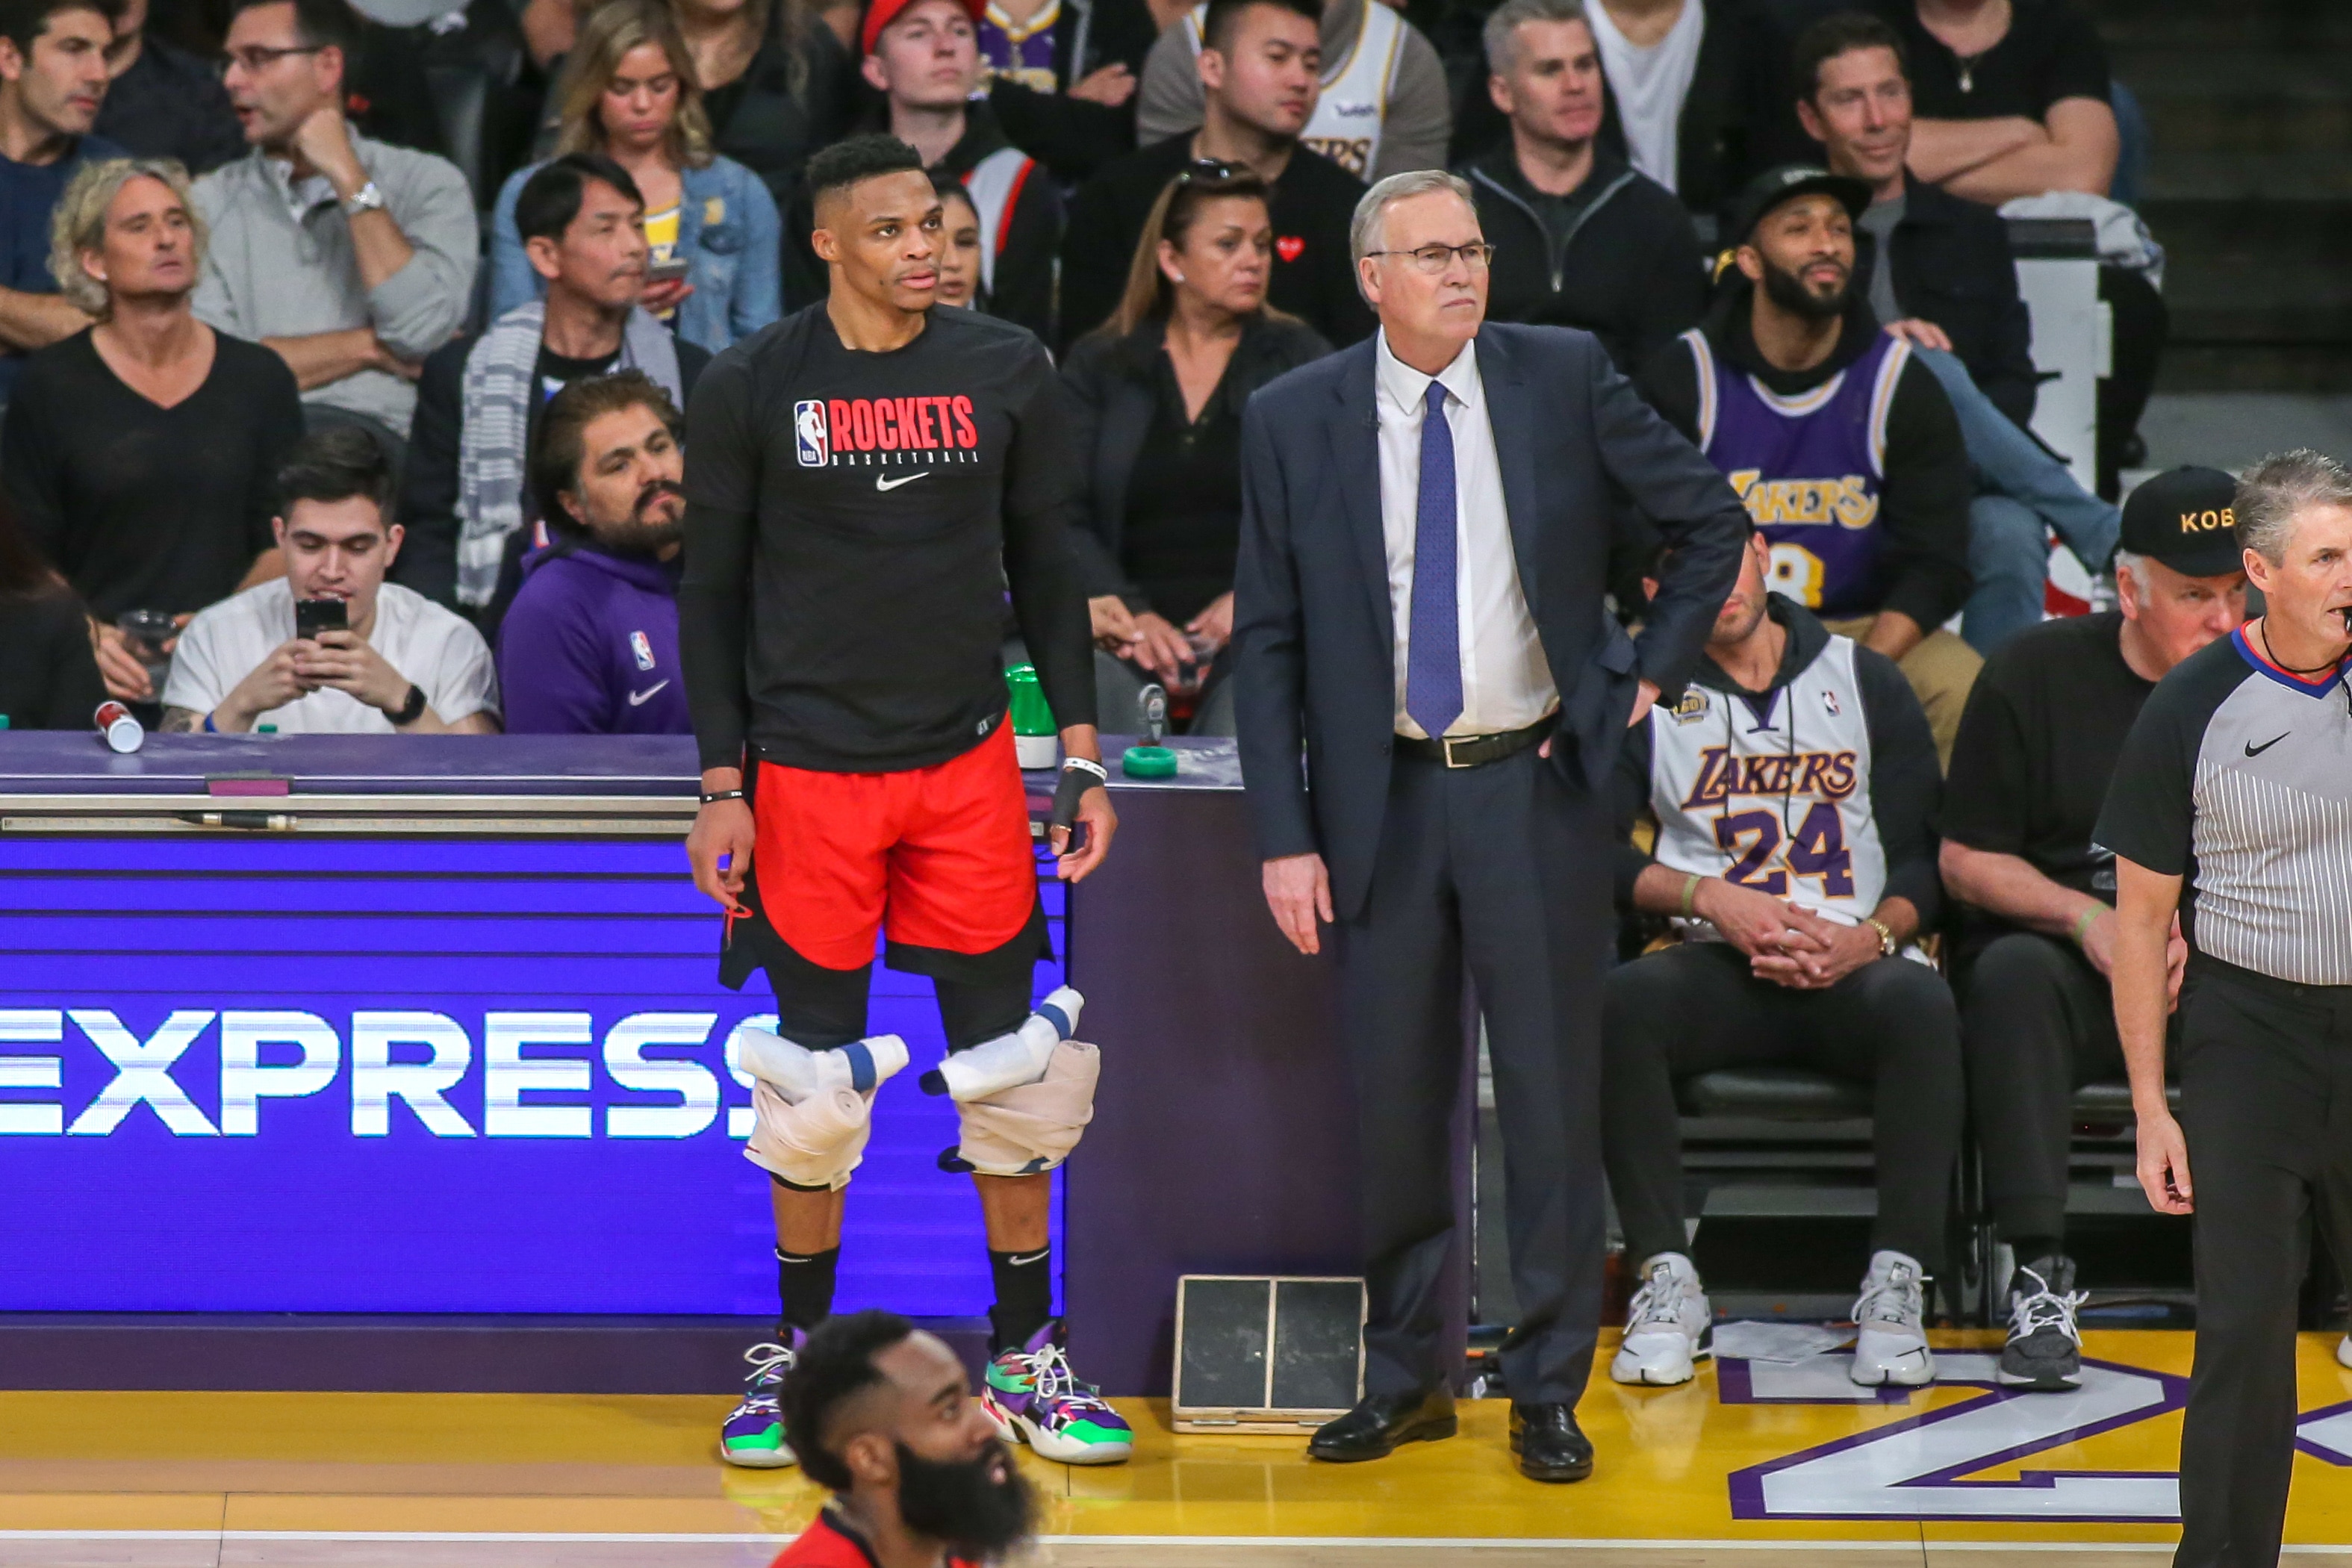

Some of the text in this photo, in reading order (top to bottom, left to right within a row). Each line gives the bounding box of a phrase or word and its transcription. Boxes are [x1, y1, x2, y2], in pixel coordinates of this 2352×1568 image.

[829, 395, 978, 452] ROCKETS
[801, 449, 817, 462] NBA
[832, 451, 978, 466] BASKETBALL
[2181, 508, 2235, 533] KOB
[1681, 744, 1858, 812] LAKERS
[1711, 801, 1855, 899] 24
